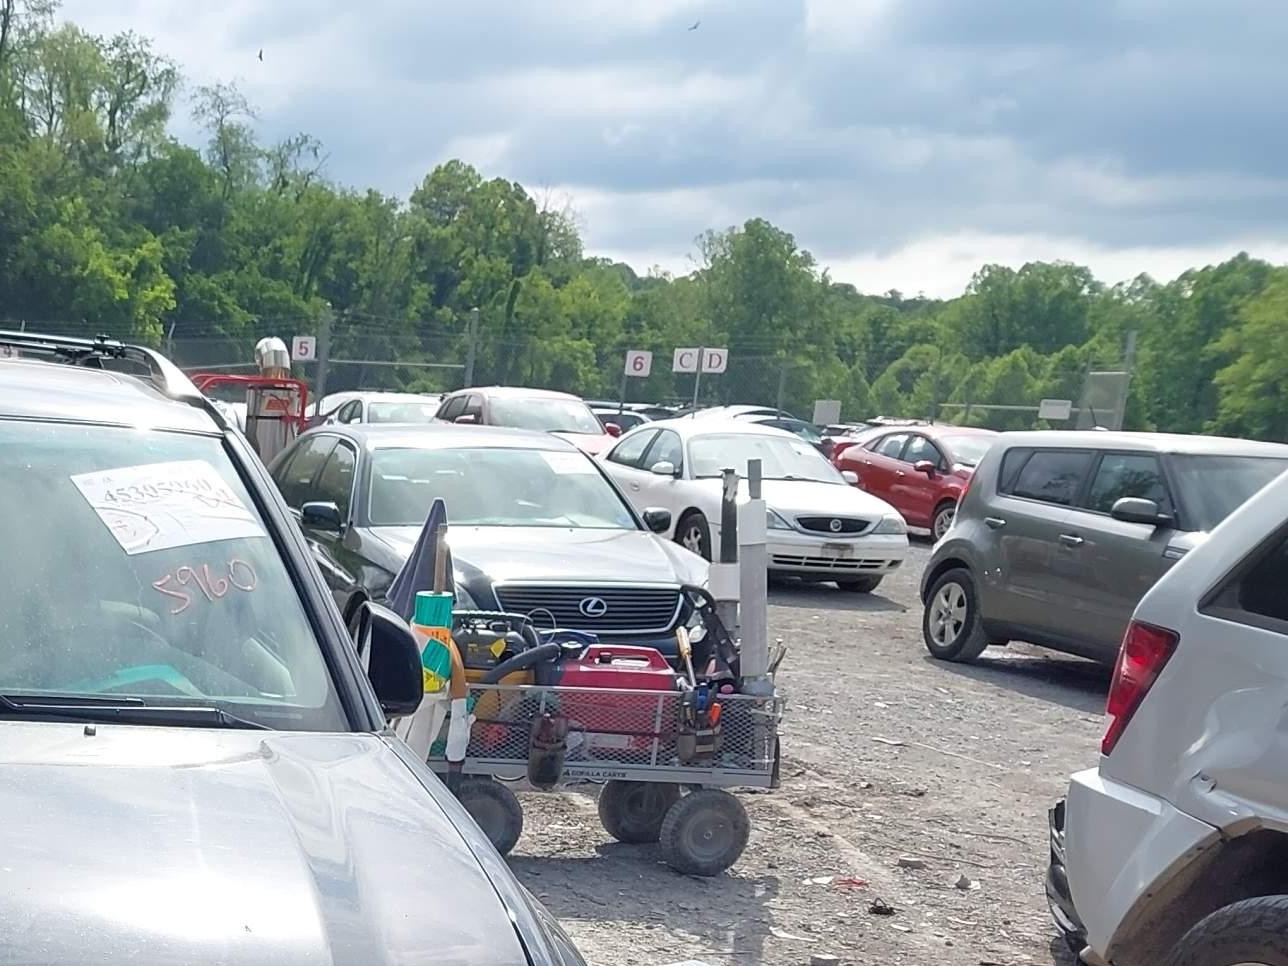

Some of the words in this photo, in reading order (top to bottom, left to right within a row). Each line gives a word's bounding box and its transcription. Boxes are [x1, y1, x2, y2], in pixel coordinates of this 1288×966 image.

[299, 341, 309, 356] 5
[633, 356, 645, 371] 6
[679, 352, 693, 369] C
[708, 353, 722, 369] D
[152, 557, 258, 616] 5960
